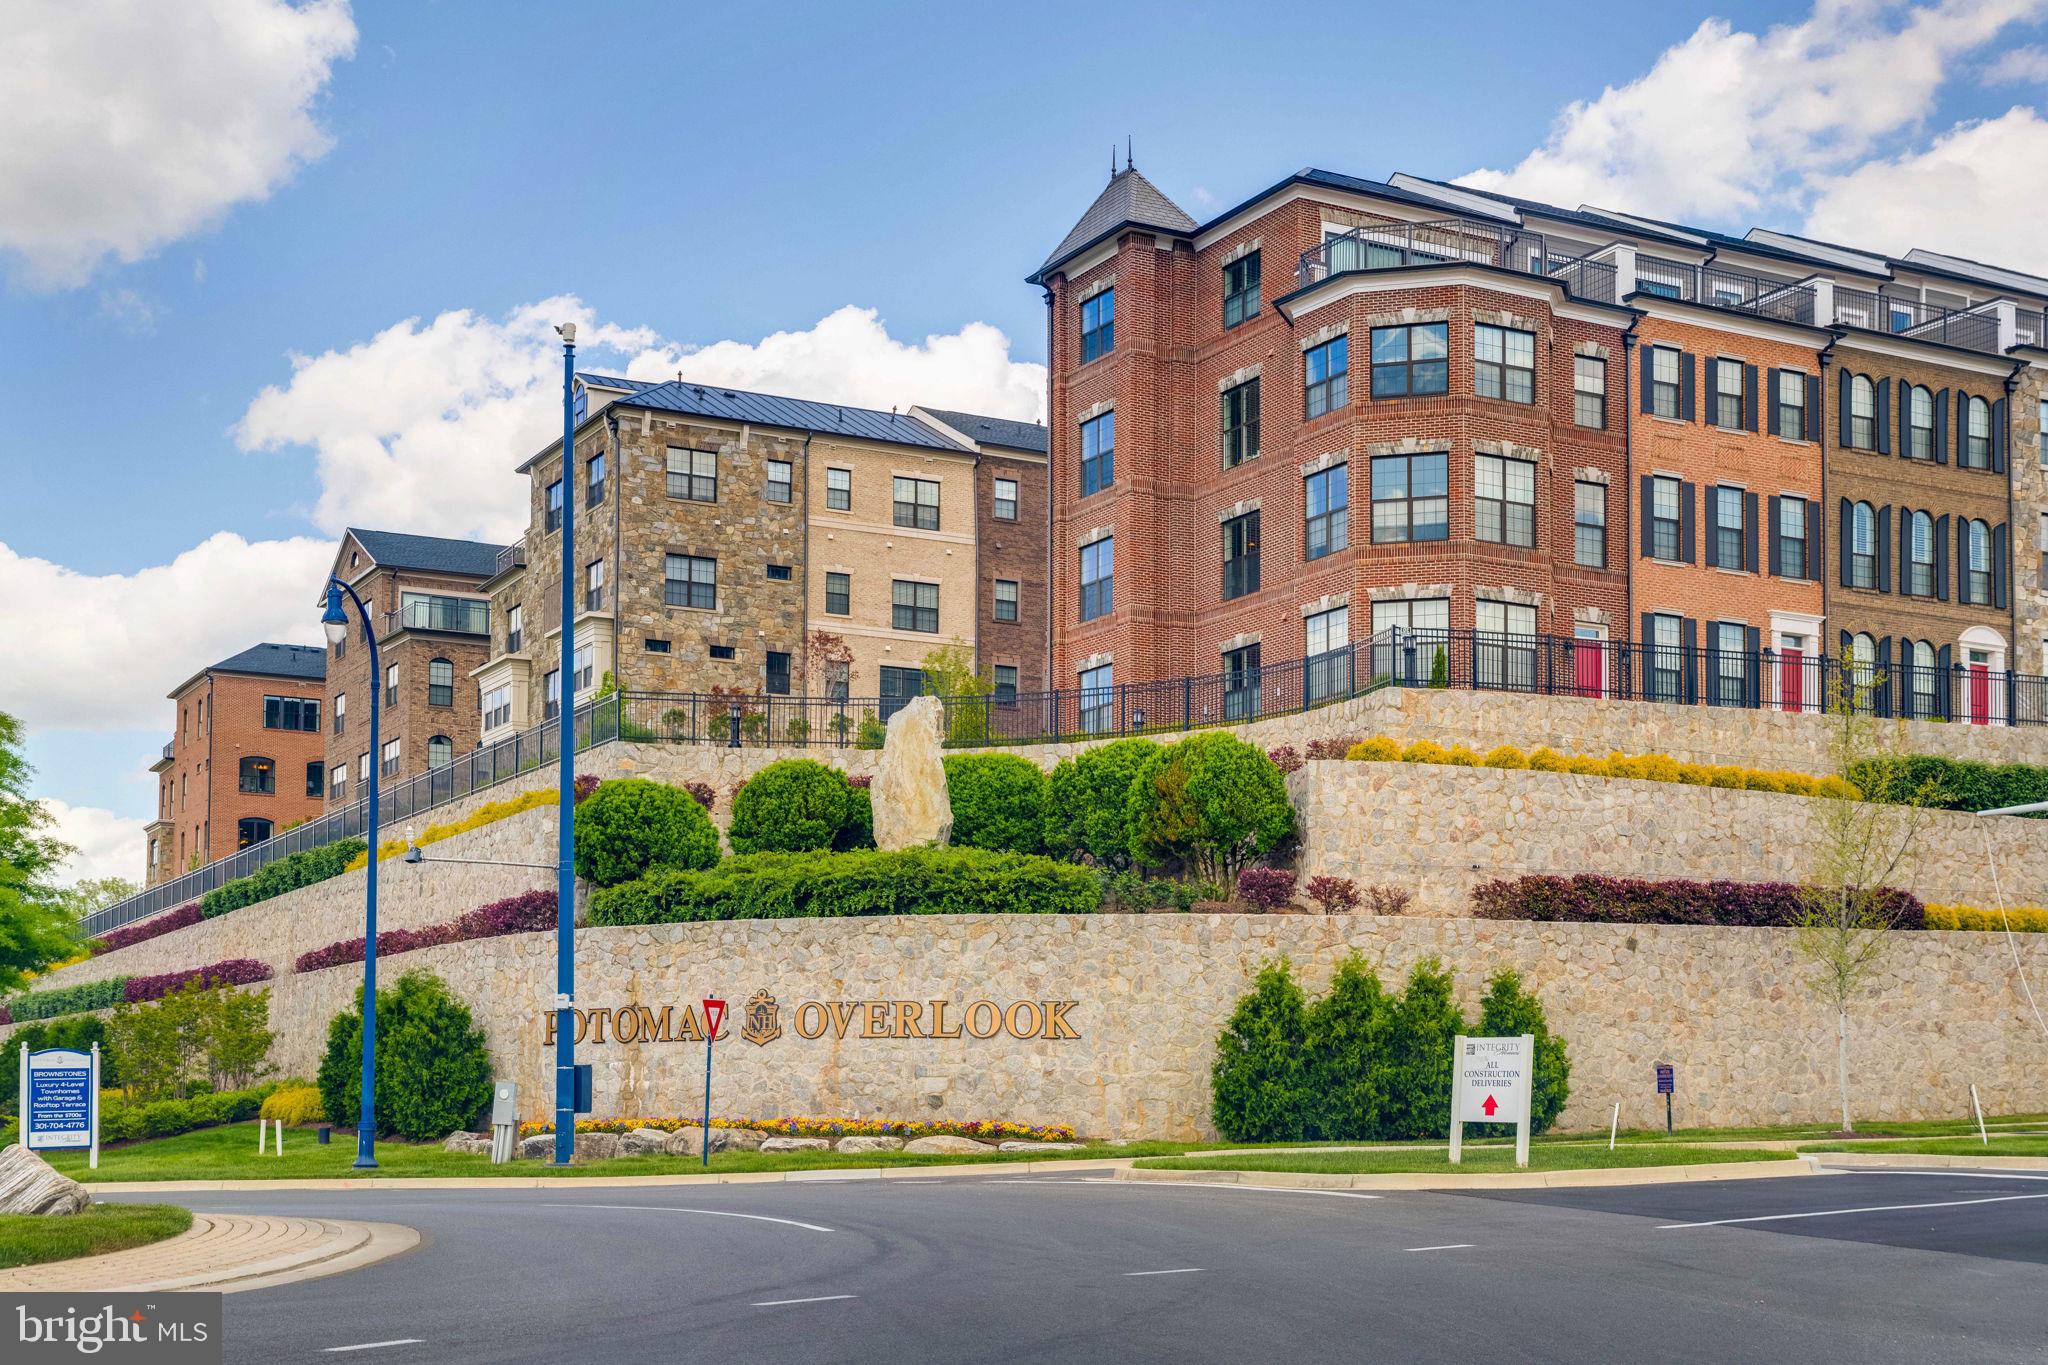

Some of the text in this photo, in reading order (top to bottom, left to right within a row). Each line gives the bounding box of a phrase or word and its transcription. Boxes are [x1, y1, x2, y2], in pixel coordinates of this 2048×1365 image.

[794, 1000, 1081, 1040] OVERLOOK
[1476, 1043, 1520, 1051] INTEGRITY
[1486, 1061, 1499, 1069] ALL
[1471, 1079, 1512, 1087] DELIVERIES
